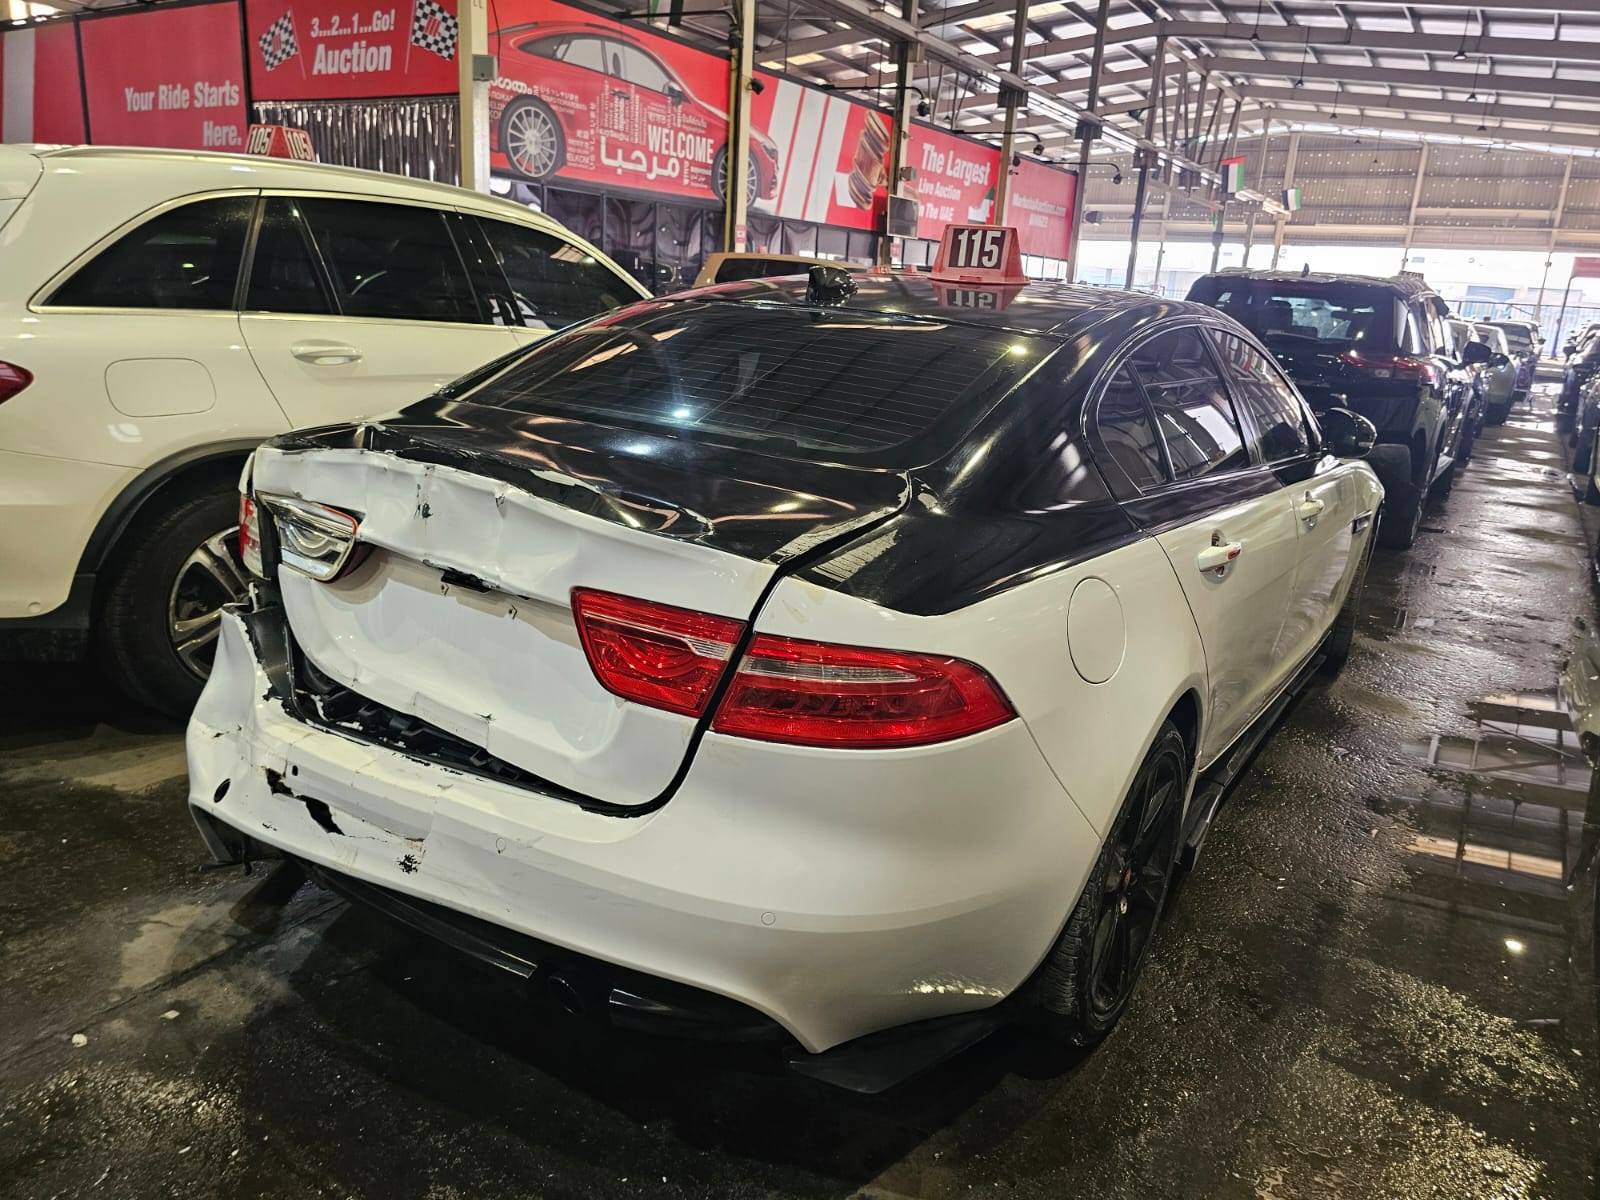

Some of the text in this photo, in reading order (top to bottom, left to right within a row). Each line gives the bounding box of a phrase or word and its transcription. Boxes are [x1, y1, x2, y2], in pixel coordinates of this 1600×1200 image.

[312, 41, 393, 76] Auction
[125, 80, 240, 112] Your Ride Starts
[203, 120, 242, 147] Here.
[249, 127, 272, 154] 105
[287, 131, 312, 161] 105
[648, 124, 714, 165] WELCOME
[601, 135, 681, 180] مرحبا
[922, 143, 991, 187] The Largest
[918, 177, 961, 201] Live Auction
[925, 202, 939, 219] The
[957, 229, 1002, 268] 115
